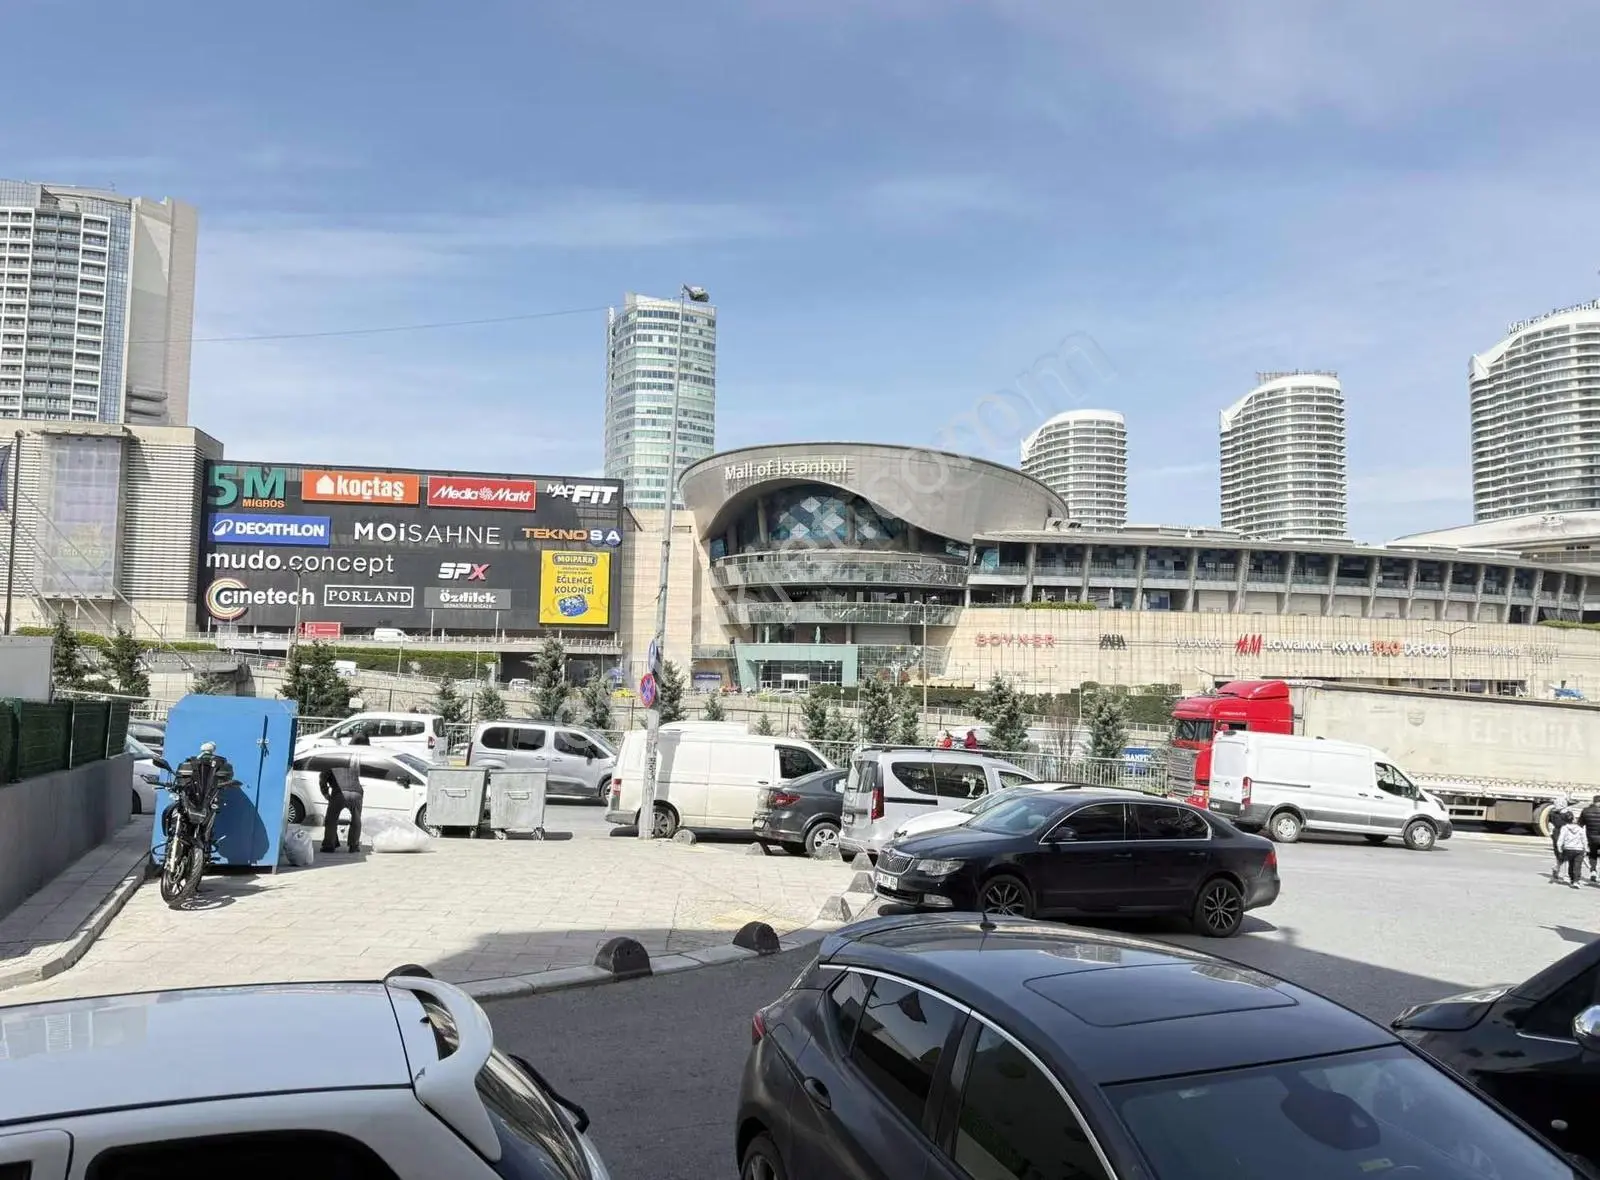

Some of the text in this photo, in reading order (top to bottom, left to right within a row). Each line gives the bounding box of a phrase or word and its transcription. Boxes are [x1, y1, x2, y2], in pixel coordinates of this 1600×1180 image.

[725, 461, 753, 480] Mall
[757, 459, 775, 476] of
[337, 475, 404, 500] koçtaş
[433, 485, 532, 502] Media Markt
[243, 499, 285, 508] MIGROS
[235, 521, 325, 537] DECATHLON
[521, 528, 621, 542] TEKNOSA
[438, 562, 491, 580] SPX
[556, 575, 593, 584] EĞLENCE
[328, 590, 411, 603] PORLAND
[440, 589, 497, 604] Özdilek
[975, 633, 1057, 648] BOYNER
